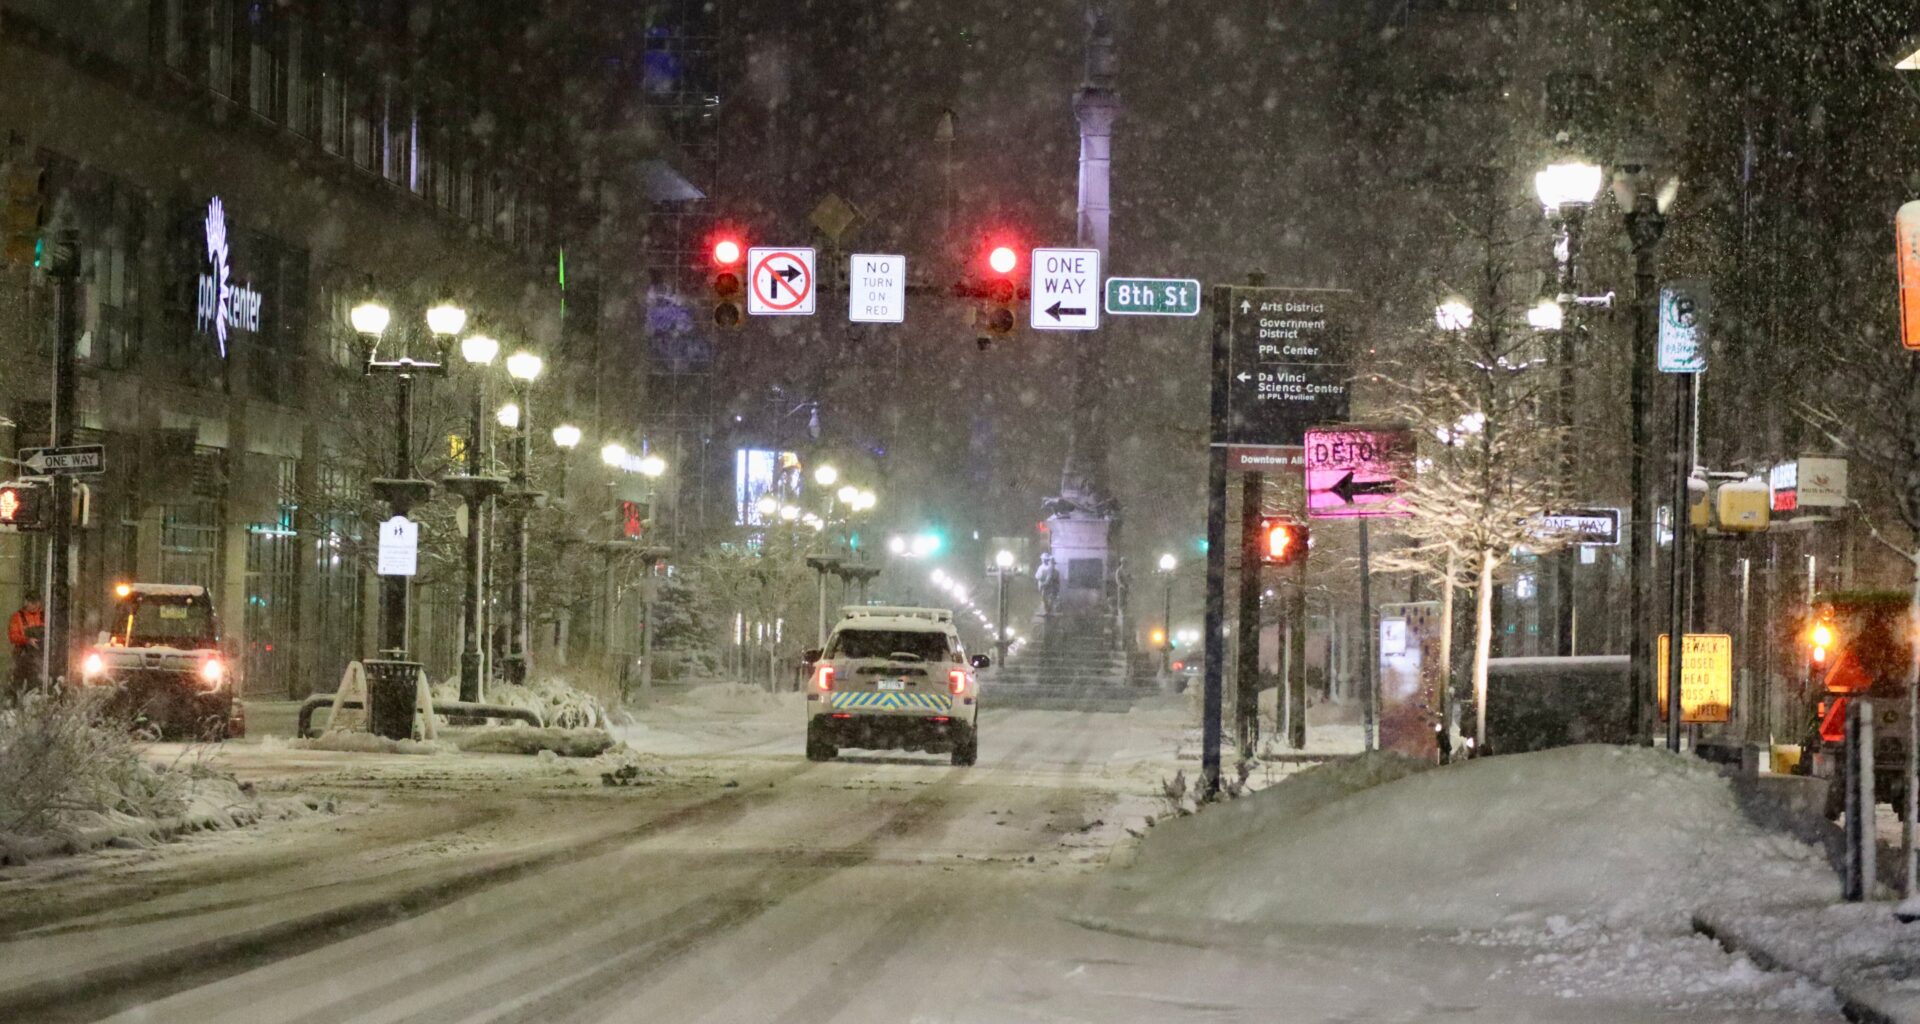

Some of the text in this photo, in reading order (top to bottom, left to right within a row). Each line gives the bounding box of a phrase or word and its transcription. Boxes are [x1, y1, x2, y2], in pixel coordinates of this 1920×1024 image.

[866, 261, 890, 274] NO
[1046, 256, 1086, 274] ONE
[863, 277, 893, 288] TURN
[1044, 277, 1087, 295] WAY
[198, 256, 262, 333] ppl center
[868, 291, 886, 302] ON
[1118, 284, 1188, 306] 8th St
[865, 305, 888, 316] RED
[1260, 302, 1325, 313] Arts District
[1259, 318, 1326, 329] Government
[1259, 328, 1298, 339] District
[1258, 344, 1320, 356] PPL Center
[1257, 372, 1307, 383] Da Vinci
[1257, 382, 1344, 394] Science Center
[1267, 392, 1282, 401] PPL
[1284, 393, 1315, 401] Pavilion
[45, 454, 94, 468] ONE WAY
[1240, 454, 1304, 465] Downtown All
[1577, 519, 1607, 533] WAY
[1681, 657, 1715, 670] LOSED
[1683, 673, 1710, 685] HEAD
